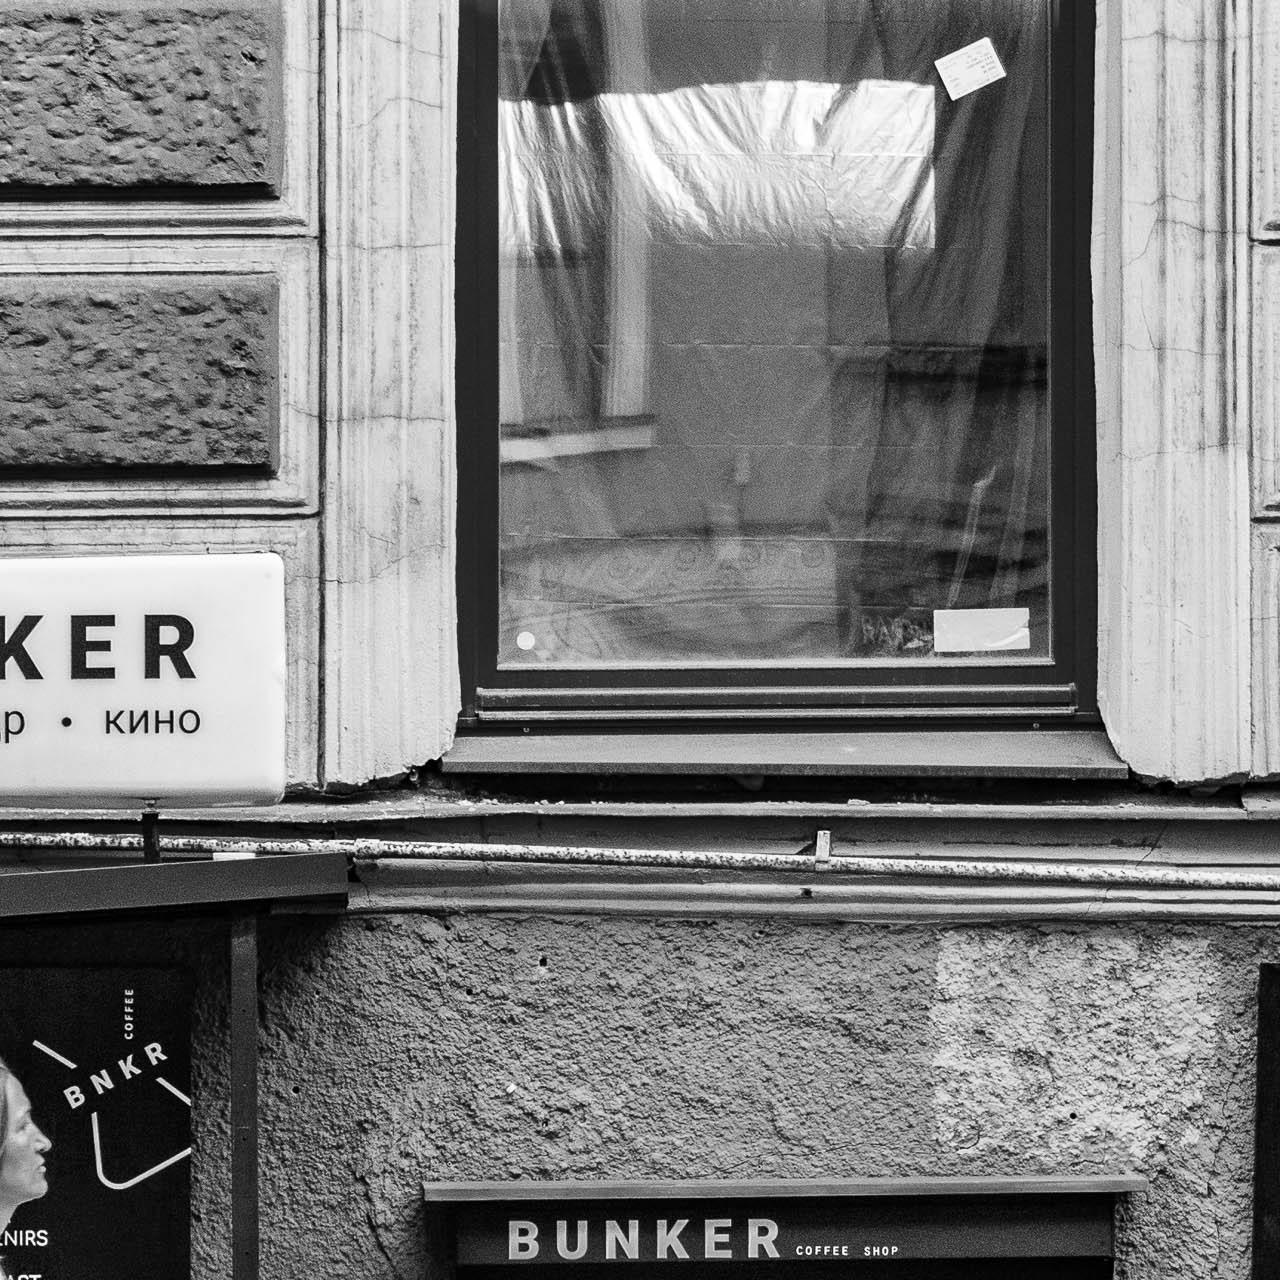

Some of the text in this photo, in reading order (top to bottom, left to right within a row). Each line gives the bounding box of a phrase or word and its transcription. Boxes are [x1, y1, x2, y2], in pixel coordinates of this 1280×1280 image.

[105, 709, 201, 734] кино
[124, 989, 134, 1040] COFFEE
[63, 1042, 168, 1109] BNKR
[508, 1218, 900, 1261] BUNKER COFFEE SHOP
